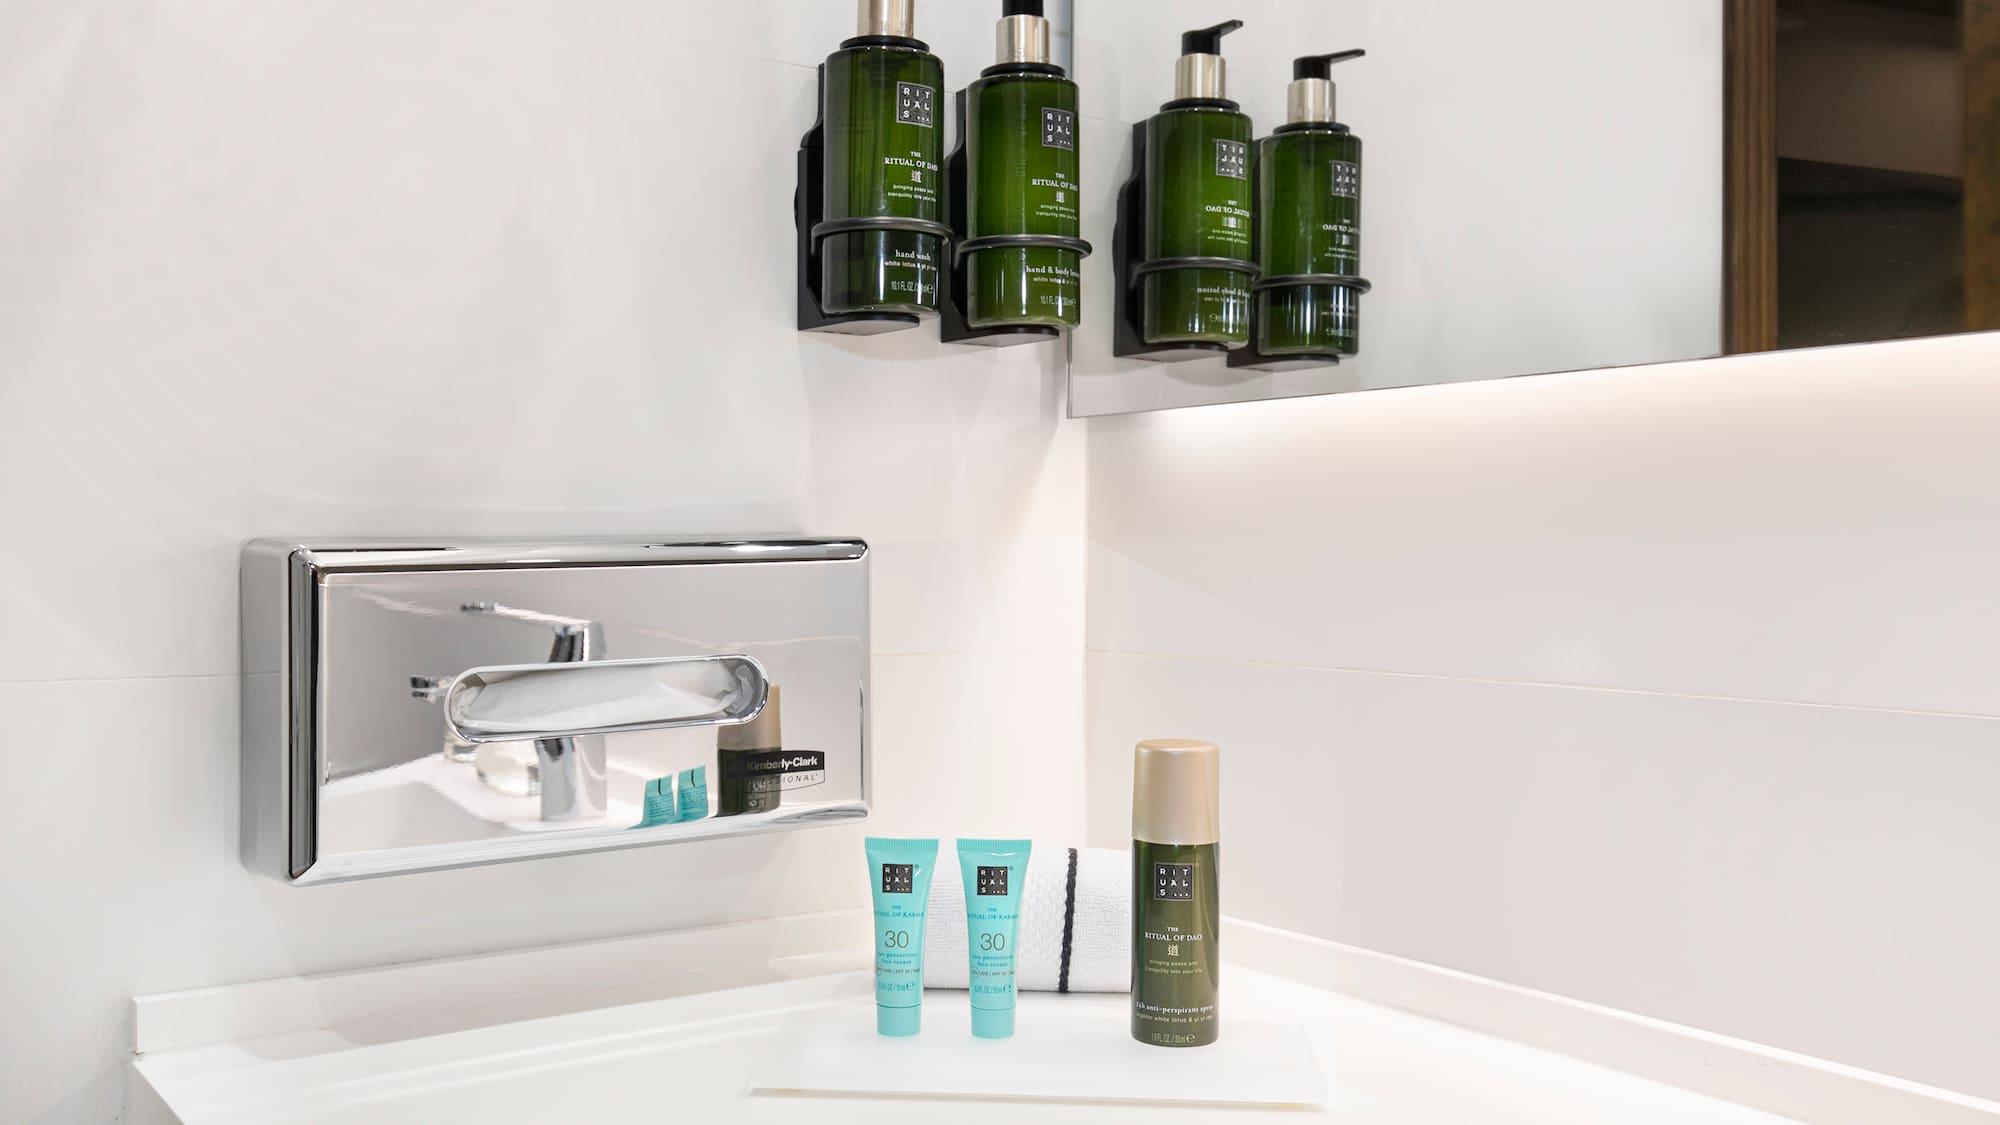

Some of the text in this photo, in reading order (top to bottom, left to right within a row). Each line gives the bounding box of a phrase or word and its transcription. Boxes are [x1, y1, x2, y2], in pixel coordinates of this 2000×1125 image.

[884, 158, 915, 167] RITUAL
[916, 160, 926, 168] OF
[1032, 178, 1060, 188] RITUAL
[1060, 181, 1068, 189] OF
[895, 249, 915, 258] hand
[1026, 265, 1046, 273] hand
[1048, 266, 1054, 274] &
[1055, 266, 1070, 278] body
[746, 756, 818, 771] Kimberly-Clark
[884, 930, 909, 949] 30
[980, 933, 1005, 951] 30
[1144, 932, 1203, 942] RITUAL OF DAO
[1168, 944, 1179, 956] 道
[1146, 1005, 1199, 1015] anti-perspirant
